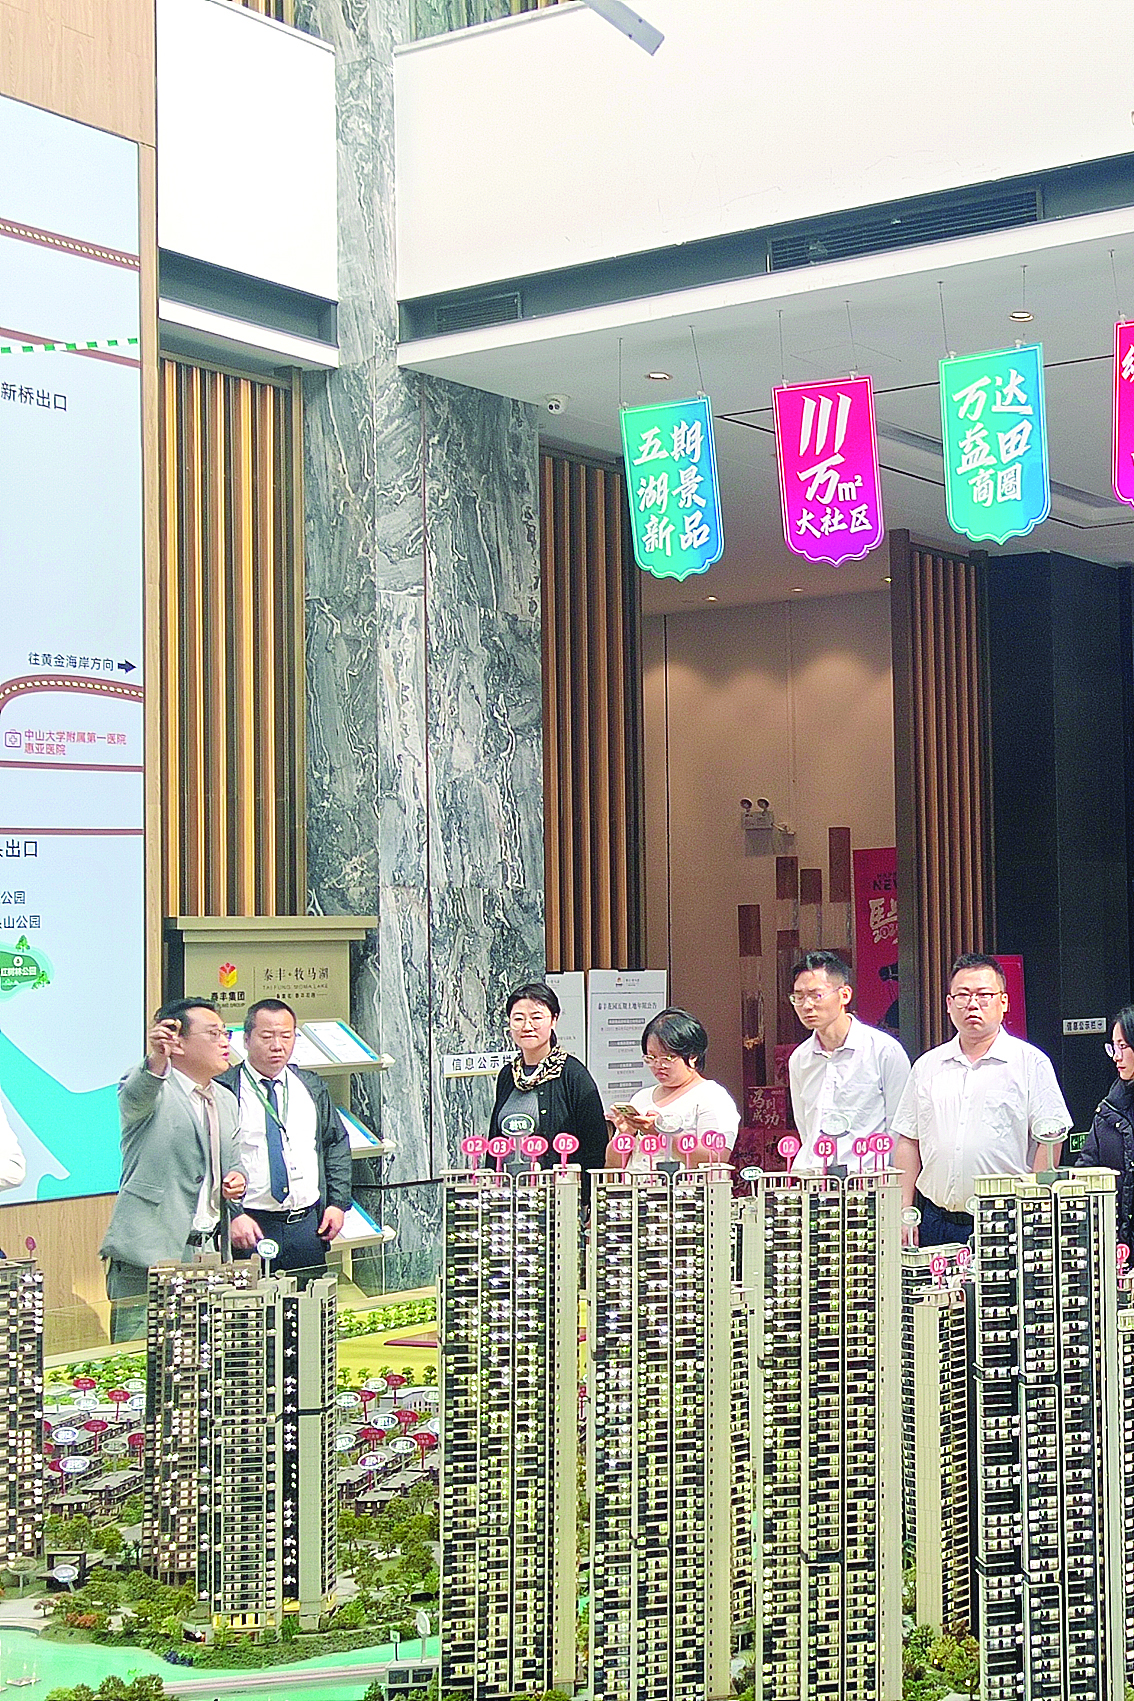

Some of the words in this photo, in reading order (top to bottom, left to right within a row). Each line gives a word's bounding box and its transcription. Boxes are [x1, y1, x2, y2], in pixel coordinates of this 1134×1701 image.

[1, 381, 67, 411] 新桥出口
[951, 369, 1033, 420] 万达
[632, 420, 704, 467] 五期
[957, 419, 1031, 475] 益田
[636, 465, 706, 513] 湖景
[968, 462, 1022, 508] 商圈
[796, 504, 872, 538] 大社区
[642, 510, 710, 556] 新品
[28, 652, 114, 671] 往黄金海岸方向
[24, 729, 127, 745] 中山大学附属第一医院
[24, 742, 66, 755] 惠亚医院
[0, 839, 38, 858] 出口
[0, 915, 41, 929] 山公园
[467, 1140, 482, 1152] 02
[493, 1142, 506, 1153] 03
[527, 1140, 542, 1152] 04
[558, 1139, 573, 1150] 05
[617, 1138, 631, 1149] 02
[644, 1139, 657, 1151] 03
[682, 1138, 694, 1150] 04
[782, 1141, 795, 1152] 02
[818, 1142, 832, 1154] 03
[876, 1138, 890, 1150] 05
